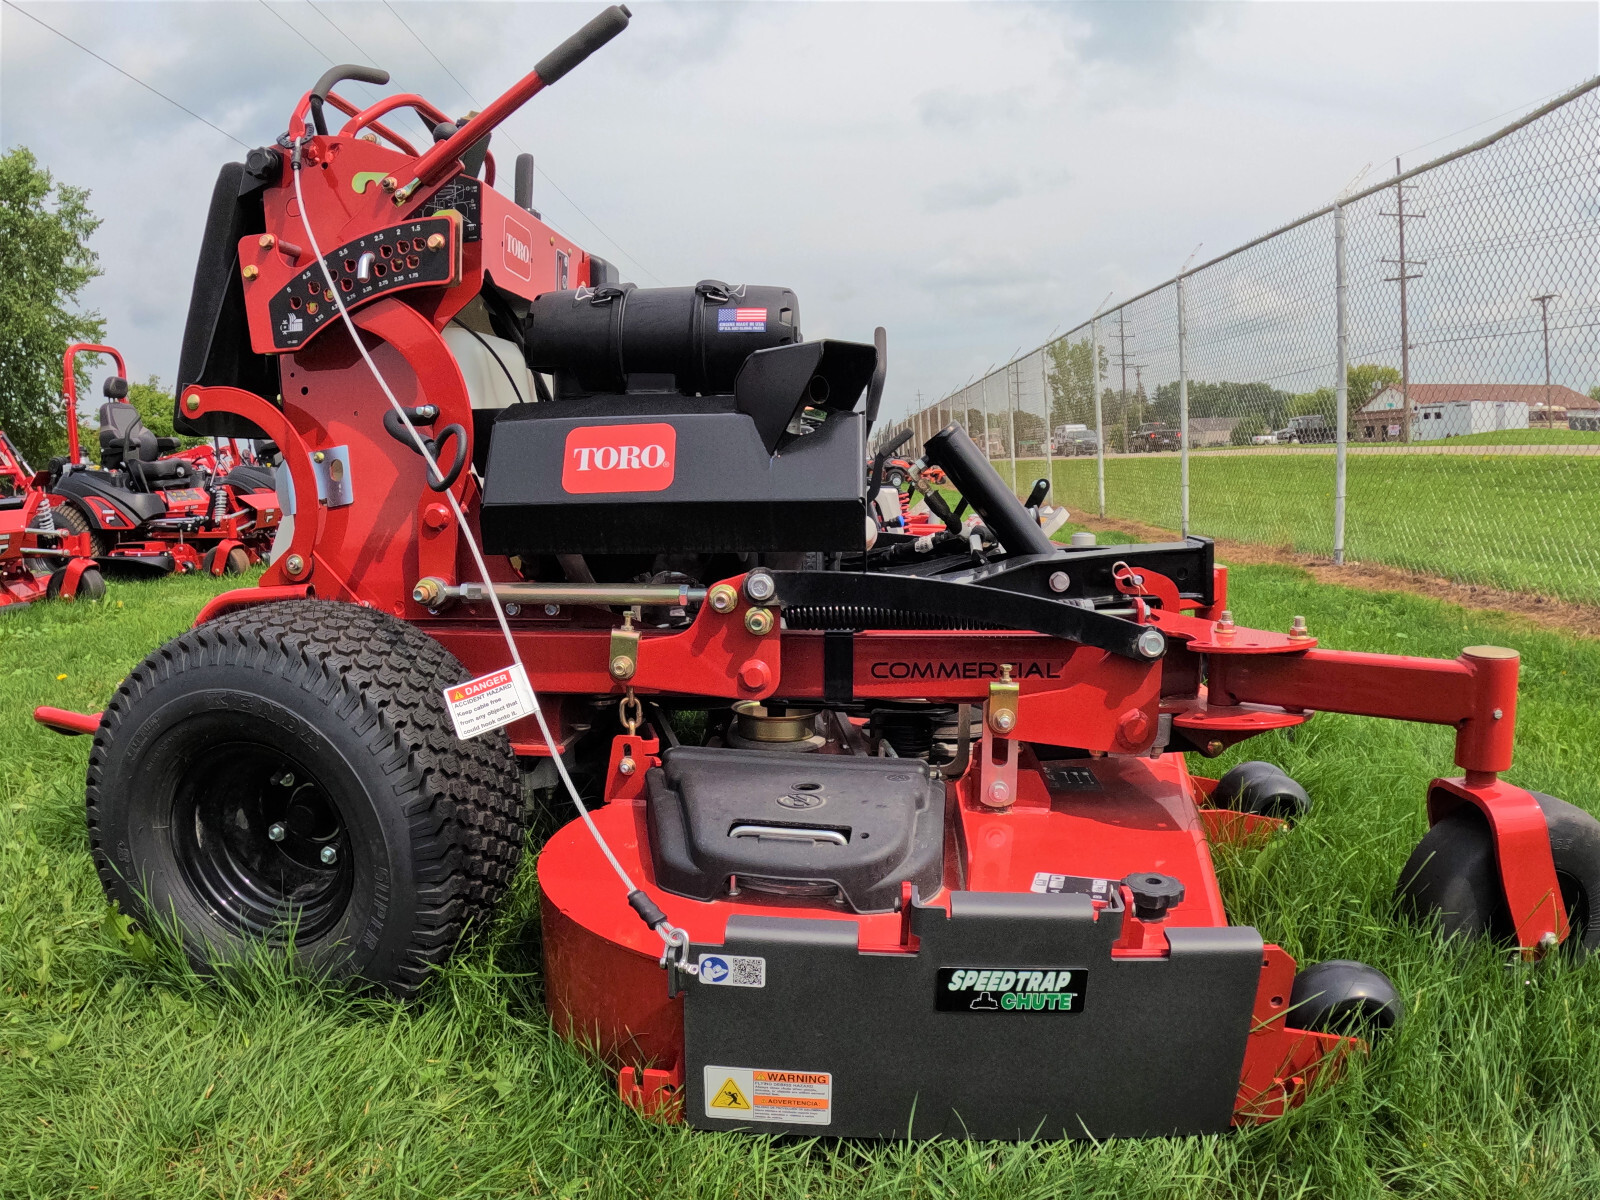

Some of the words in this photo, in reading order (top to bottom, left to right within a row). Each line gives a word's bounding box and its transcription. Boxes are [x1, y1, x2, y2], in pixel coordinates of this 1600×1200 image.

[302, 271, 311, 280] 4.5
[339, 248, 349, 257] 3.5
[374, 233, 384, 242] 2.5
[411, 224, 421, 232] 1.5
[506, 233, 530, 263] TORO
[573, 444, 666, 471] TORO
[871, 662, 1061, 679] COMMERCIAL
[454, 694, 485, 708] ACCIDENT
[486, 683, 512, 697] HAZARD
[464, 674, 508, 696] DANGER
[457, 709, 473, 718] Keep
[474, 702, 490, 712] cable
[490, 698, 502, 706] free
[460, 718, 474, 726] from
[476, 713, 486, 722] any
[487, 705, 506, 716] object
[464, 725, 480, 735] could
[481, 720, 496, 728] hook
[496, 714, 510, 722] onto
[948, 970, 1071, 992] SPEEDTRAP
[1000, 992, 1072, 1010] CHUTE
[768, 1073, 826, 1084] WARNING
